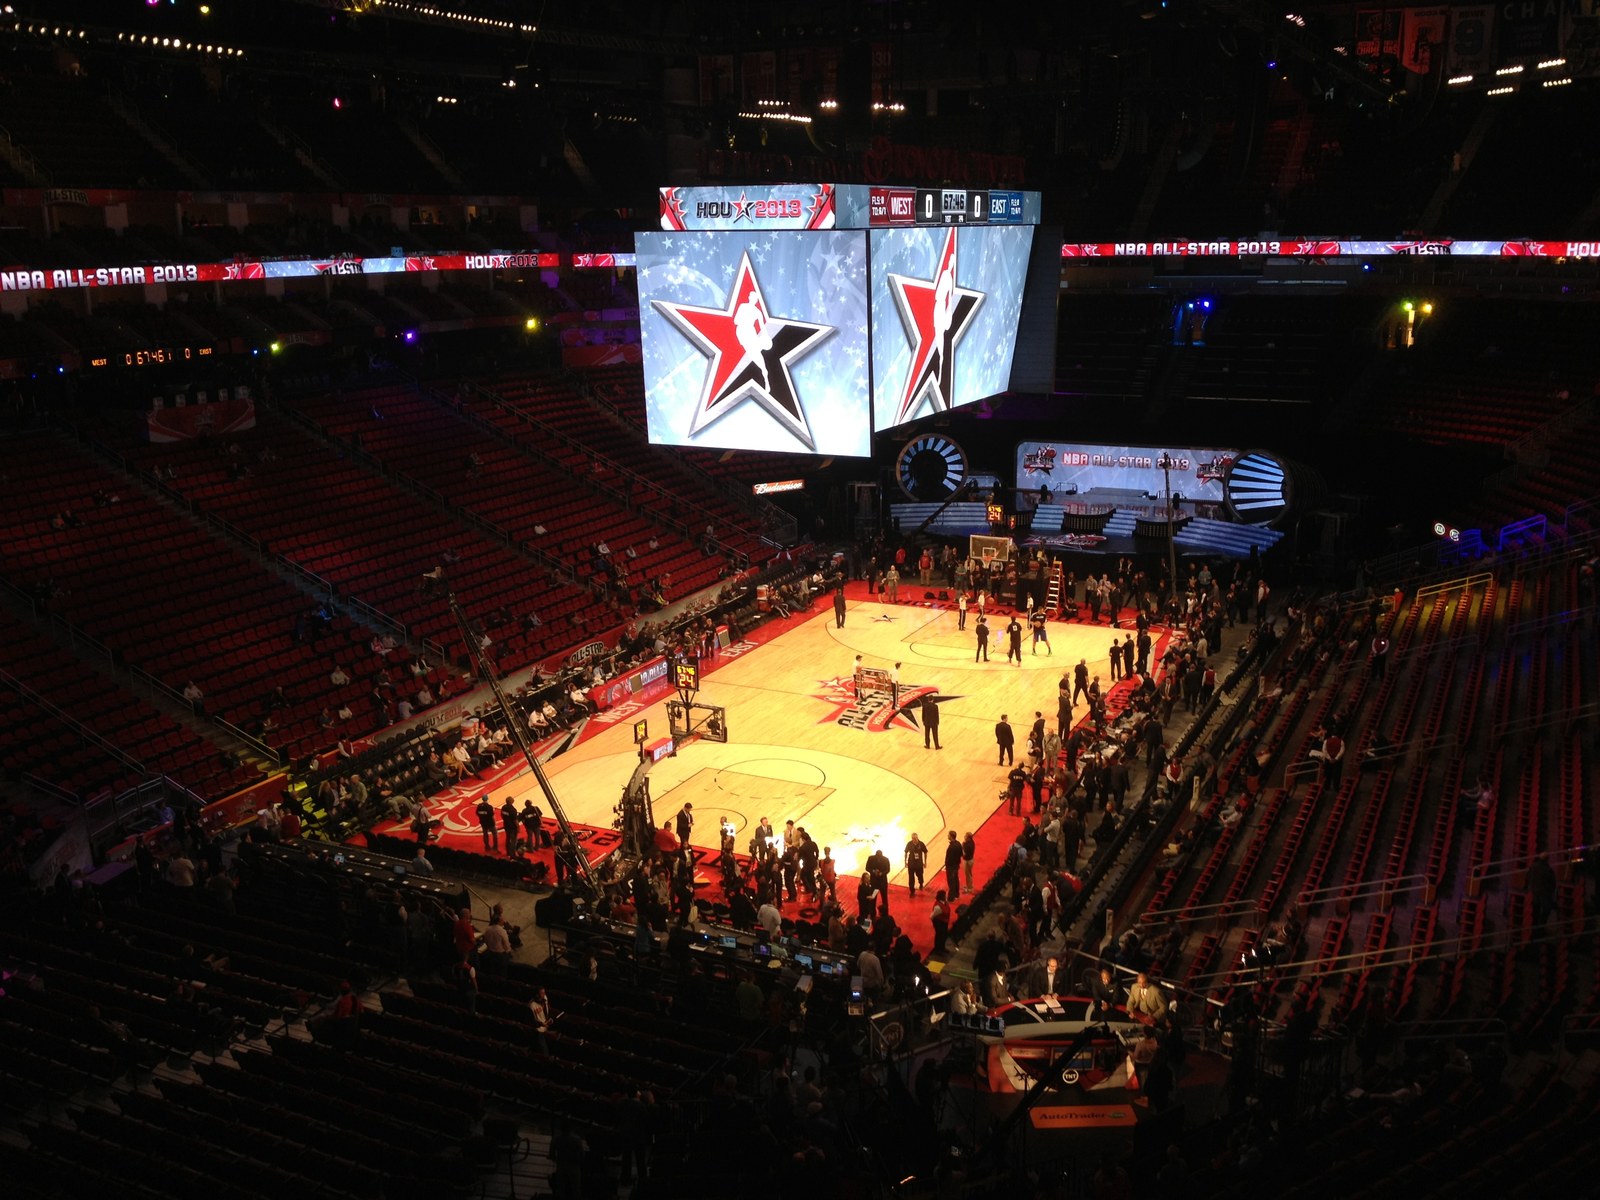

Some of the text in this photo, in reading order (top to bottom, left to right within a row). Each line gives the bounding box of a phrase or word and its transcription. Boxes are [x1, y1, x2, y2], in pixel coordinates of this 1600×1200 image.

[697, 199, 801, 218] HOU 2013
[891, 196, 912, 215] WEST
[925, 194, 933, 219] 0
[944, 193, 965, 211] 67:46
[974, 195, 981, 218] 0
[991, 199, 1006, 214] EAST
[1114, 241, 1280, 256] NBA ALL-STAR 2013
[465, 254, 538, 269] HOU 2013
[1, 265, 198, 290] NBA ALL-STAR 2013
[1063, 452, 1089, 465] NBA
[1092, 454, 1151, 468] ALL-STAR
[753, 482, 803, 494] Budweiser
[719, 640, 758, 657] EAST
[680, 674, 694, 686] 24
[593, 701, 645, 723] WEST
[1064, 1073, 1077, 1081] TNT
[1040, 1112, 1105, 1120] AutoTrader
